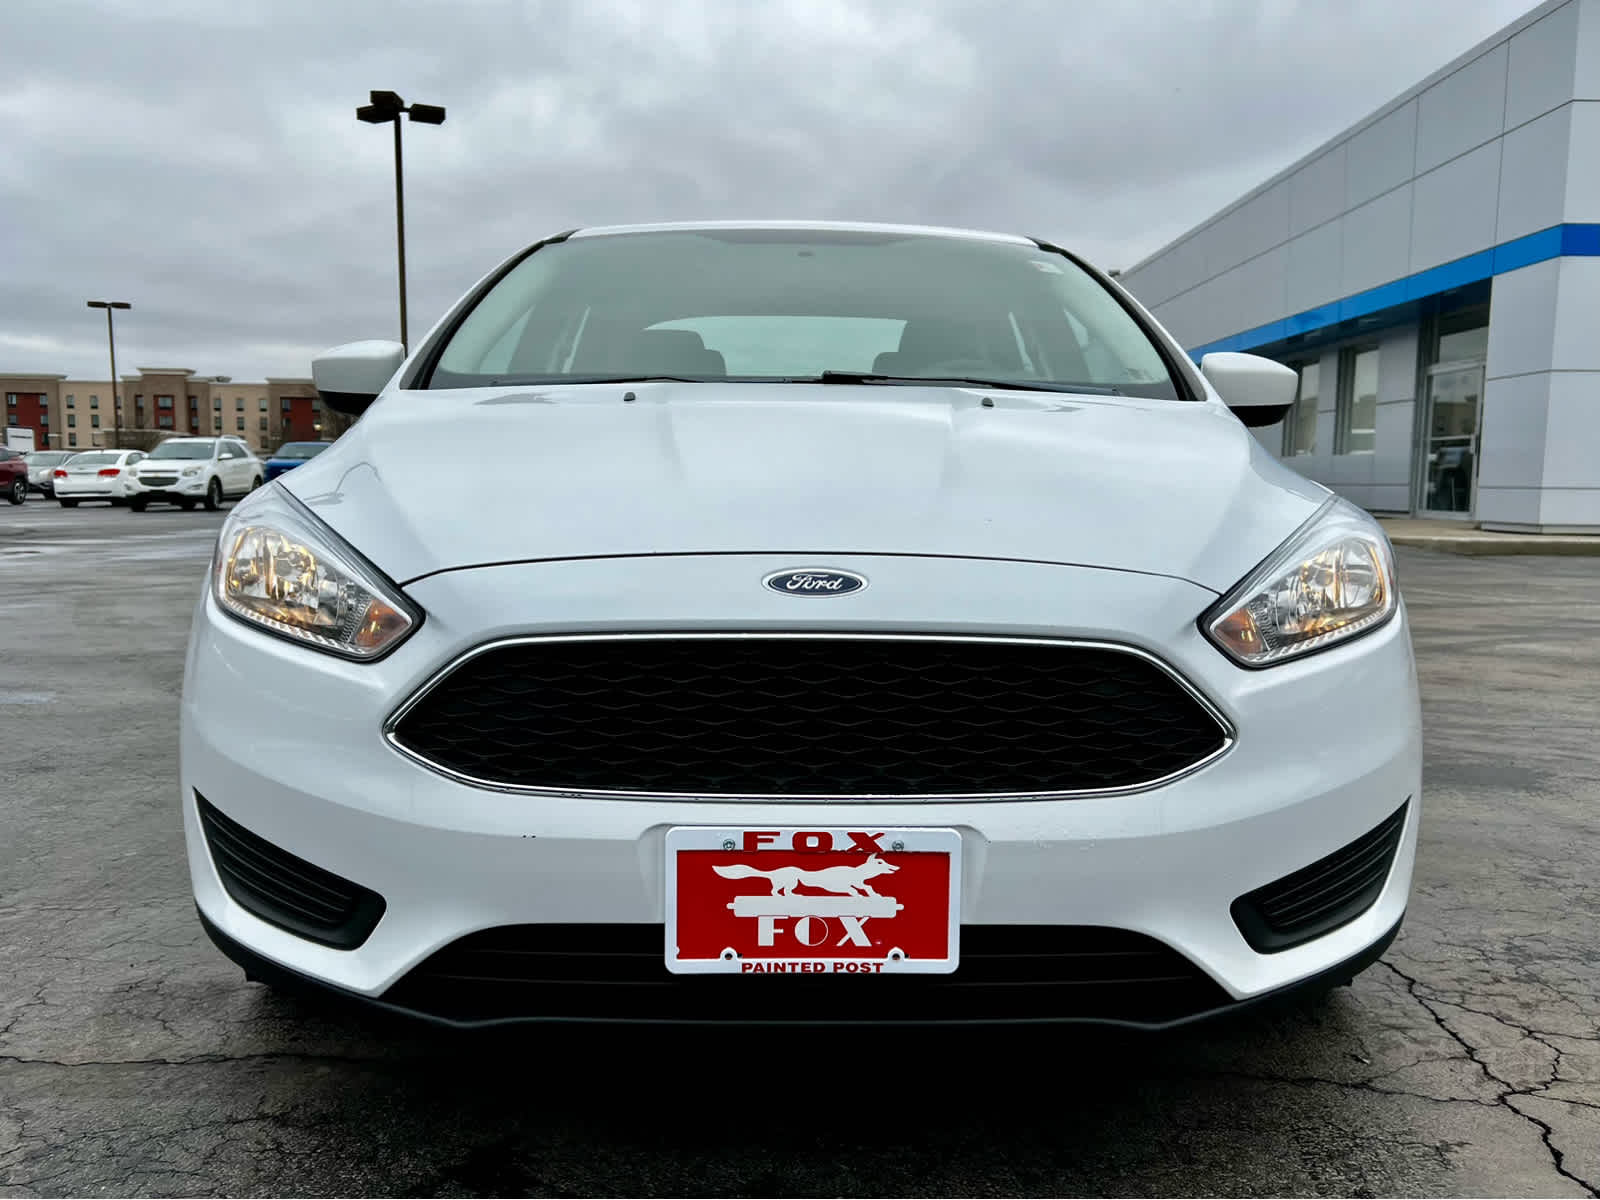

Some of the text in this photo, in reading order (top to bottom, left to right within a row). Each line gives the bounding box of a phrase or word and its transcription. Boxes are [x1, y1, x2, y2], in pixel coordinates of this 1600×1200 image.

[786, 573, 844, 590] Ford
[743, 831, 885, 852] FOX
[758, 916, 872, 947] FOX
[741, 962, 884, 973] PAINTED POST
